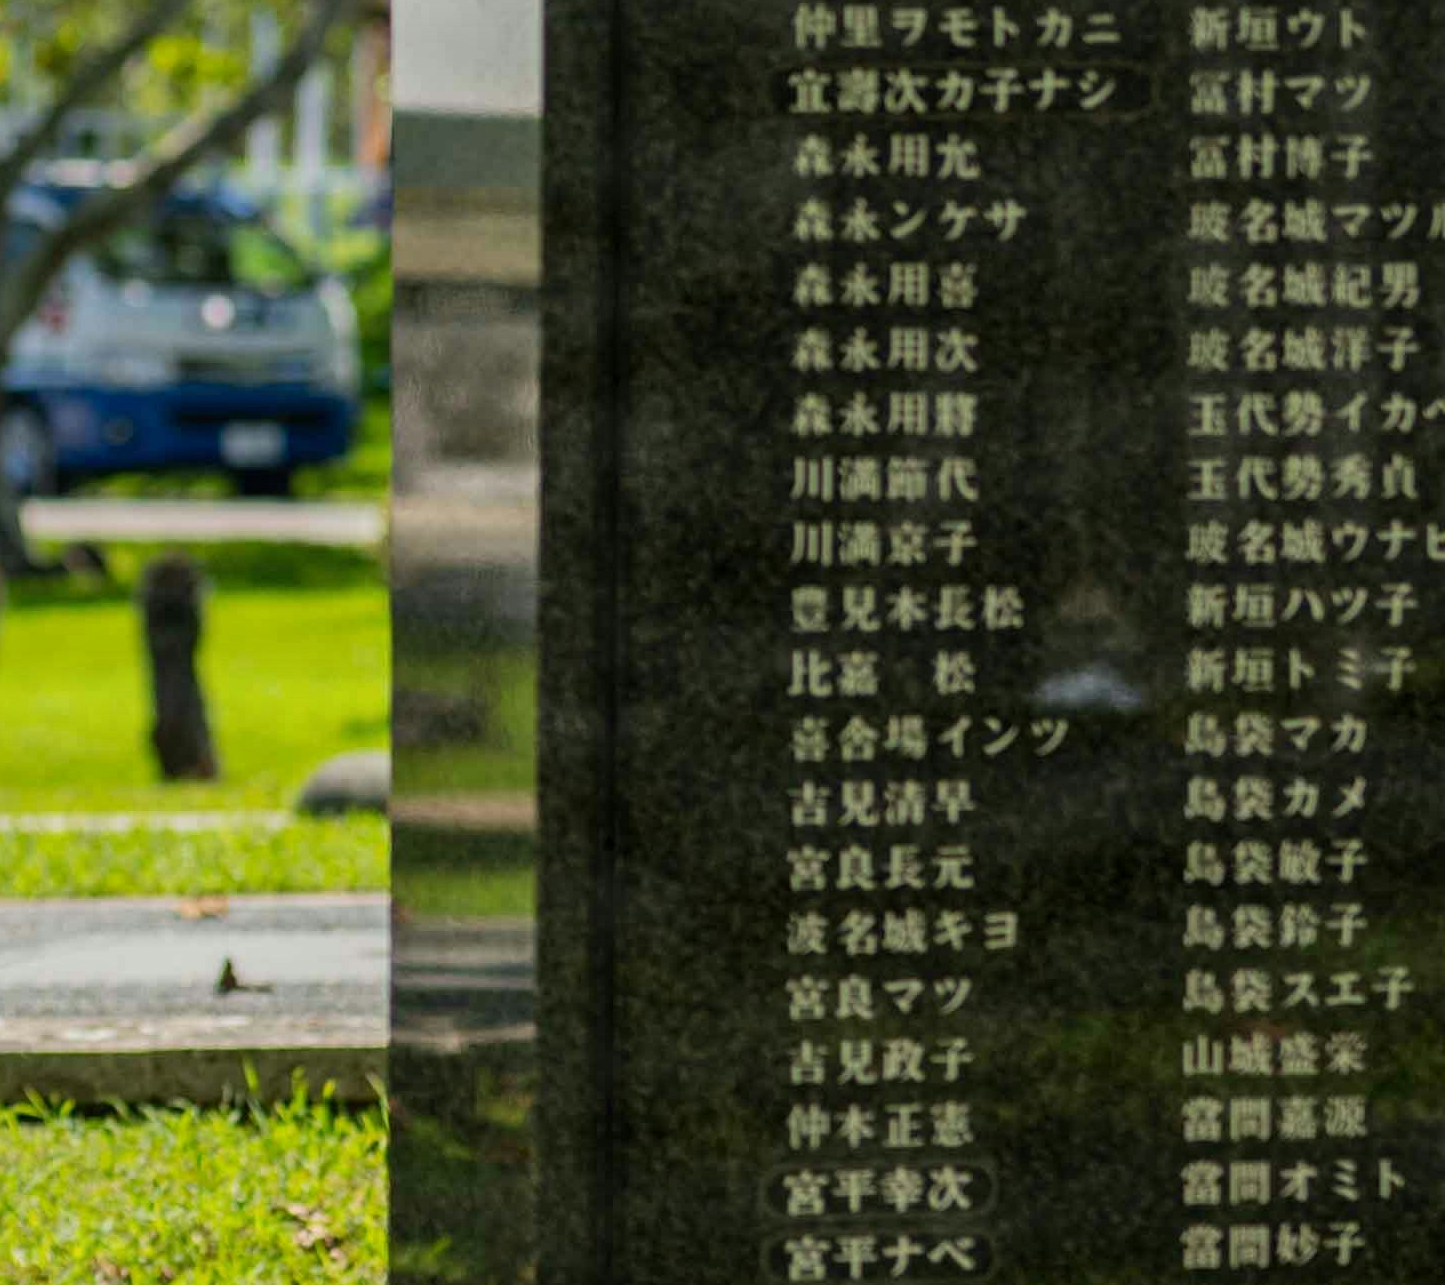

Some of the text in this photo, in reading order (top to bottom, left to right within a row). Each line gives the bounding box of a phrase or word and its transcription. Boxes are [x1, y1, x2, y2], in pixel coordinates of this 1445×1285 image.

[792, 3, 1121, 49] 仲里ヲモトカニ
[1190, 6, 1368, 49] 新垣ウト
[793, 198, 1028, 242] 森永ンケサ
[792, 327, 978, 372] 森永用次
[1187, 581, 1418, 628] 新垣ハツ子
[1186, 645, 1418, 692] 新垣トミ子
[1183, 712, 1368, 757] 島袋マカ
[1183, 776, 1368, 822] 島袋カメ
[785, 844, 975, 891] 宮良長元
[1183, 838, 1368, 885] 島袋敏子
[1182, 902, 1368, 950] 島袋鈴子
[785, 974, 972, 1021] 宮良マツ
[1182, 963, 1416, 1014] 島袋スエ子
[789, 1036, 974, 1085] 吉見政子
[782, 1165, 972, 1217] 宮平幸次
